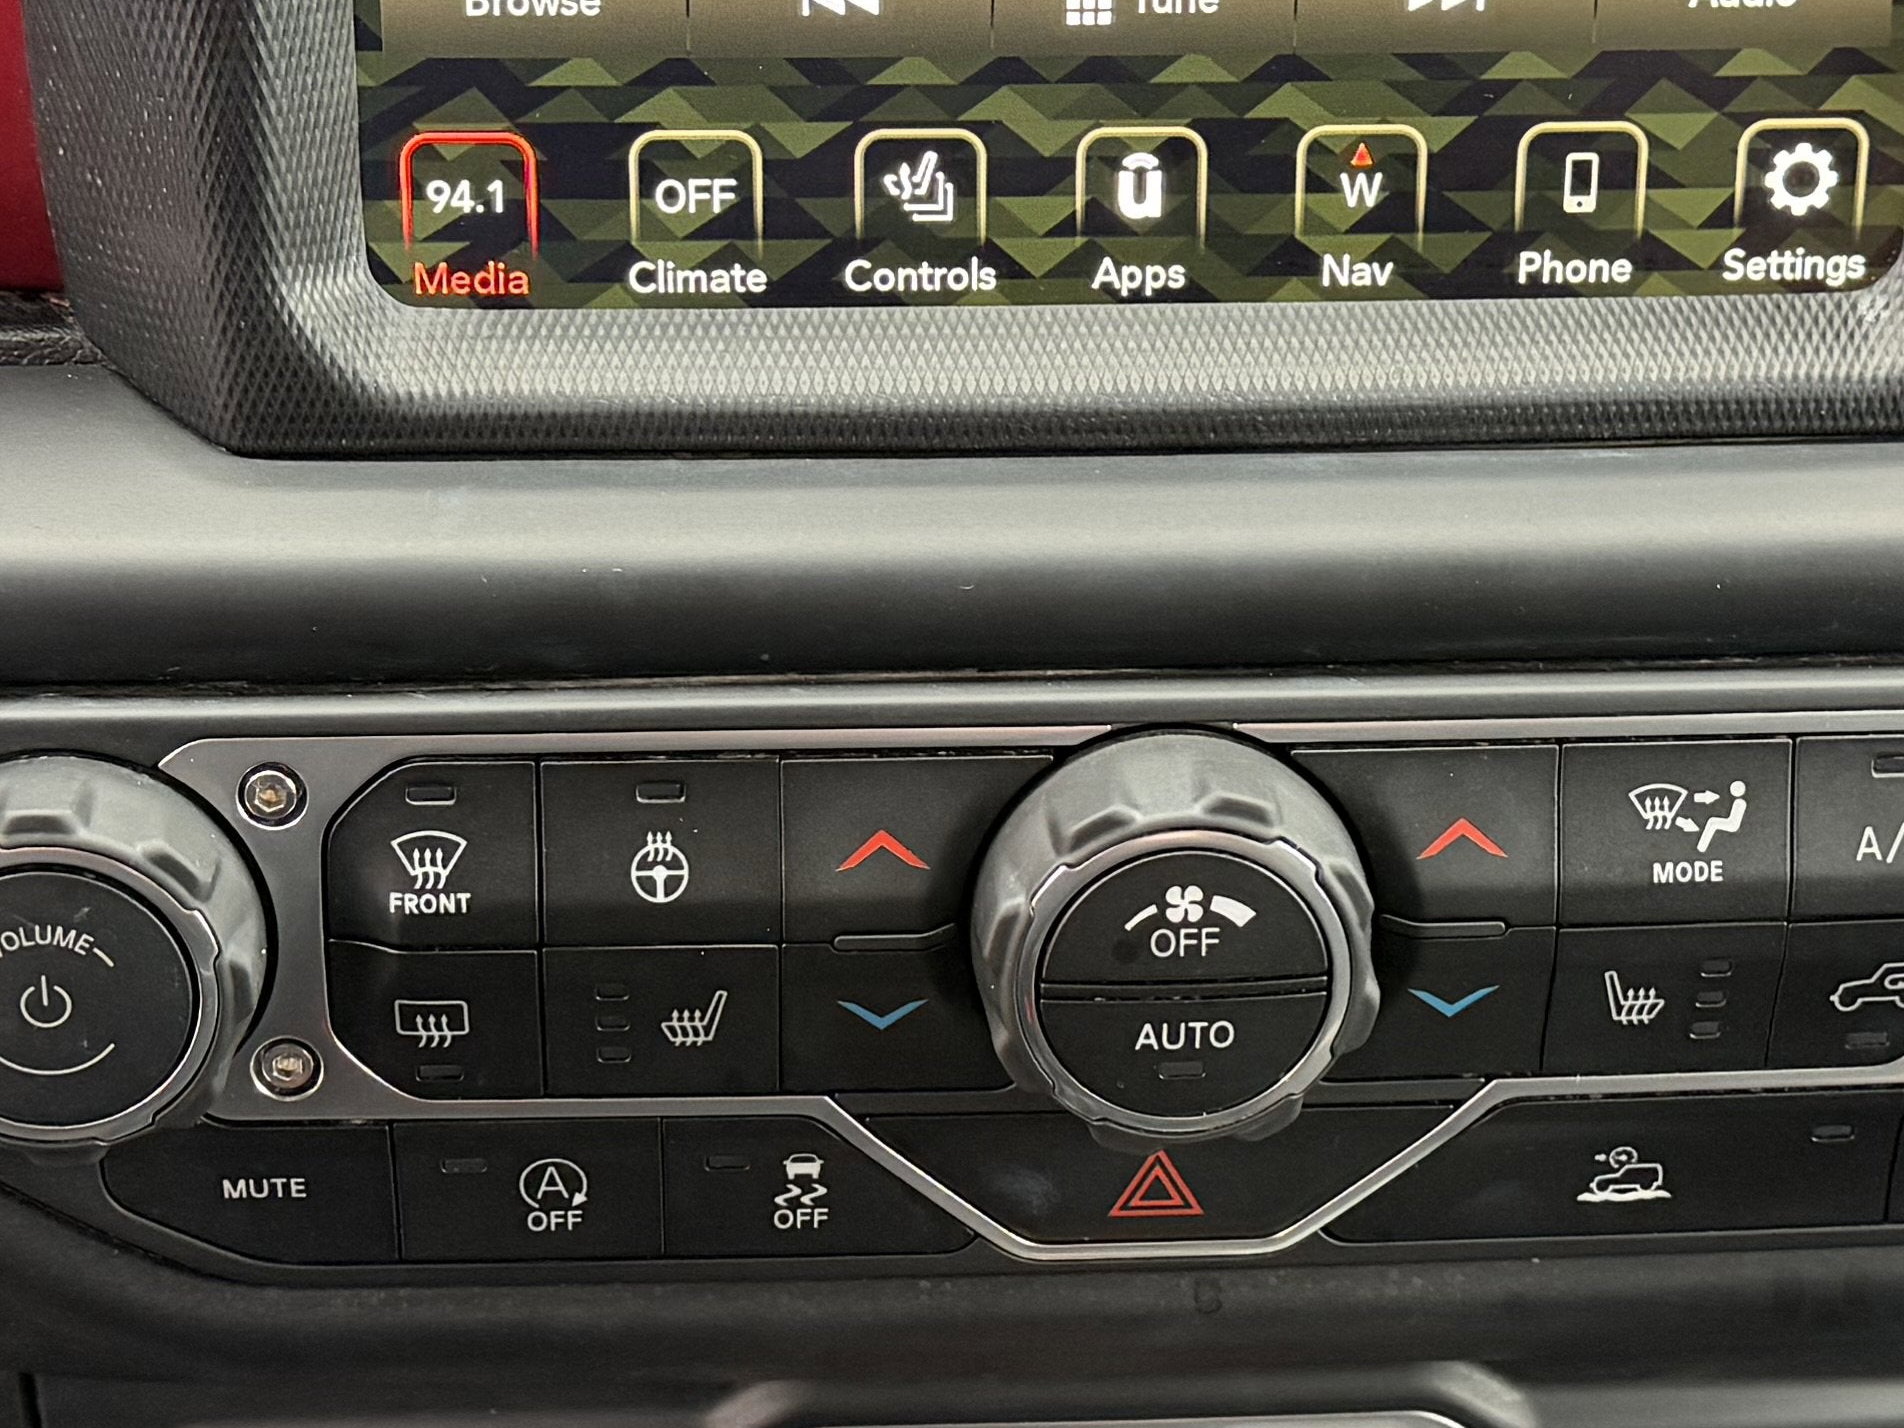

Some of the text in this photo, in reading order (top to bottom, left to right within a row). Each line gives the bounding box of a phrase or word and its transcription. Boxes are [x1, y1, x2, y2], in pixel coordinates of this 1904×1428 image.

[426, 179, 504, 214] 94.1
[655, 179, 737, 214] OFF
[1339, 172, 1383, 208] W
[414, 261, 530, 295] Media
[629, 260, 768, 294] Climate
[844, 257, 997, 292] Controls
[1092, 257, 1186, 296] Apps
[1322, 254, 1393, 287] Nav
[1518, 250, 1633, 284] Phone
[1722, 248, 1866, 286] Settings
[1652, 861, 1724, 884] MODE
[389, 892, 471, 914] FRONT
[1150, 928, 1221, 958] OFF
[1135, 1021, 1235, 1051] AUTO
[222, 1178, 307, 1199] MUTE
[527, 1210, 583, 1232] OFF
[773, 1208, 829, 1229] OFF
